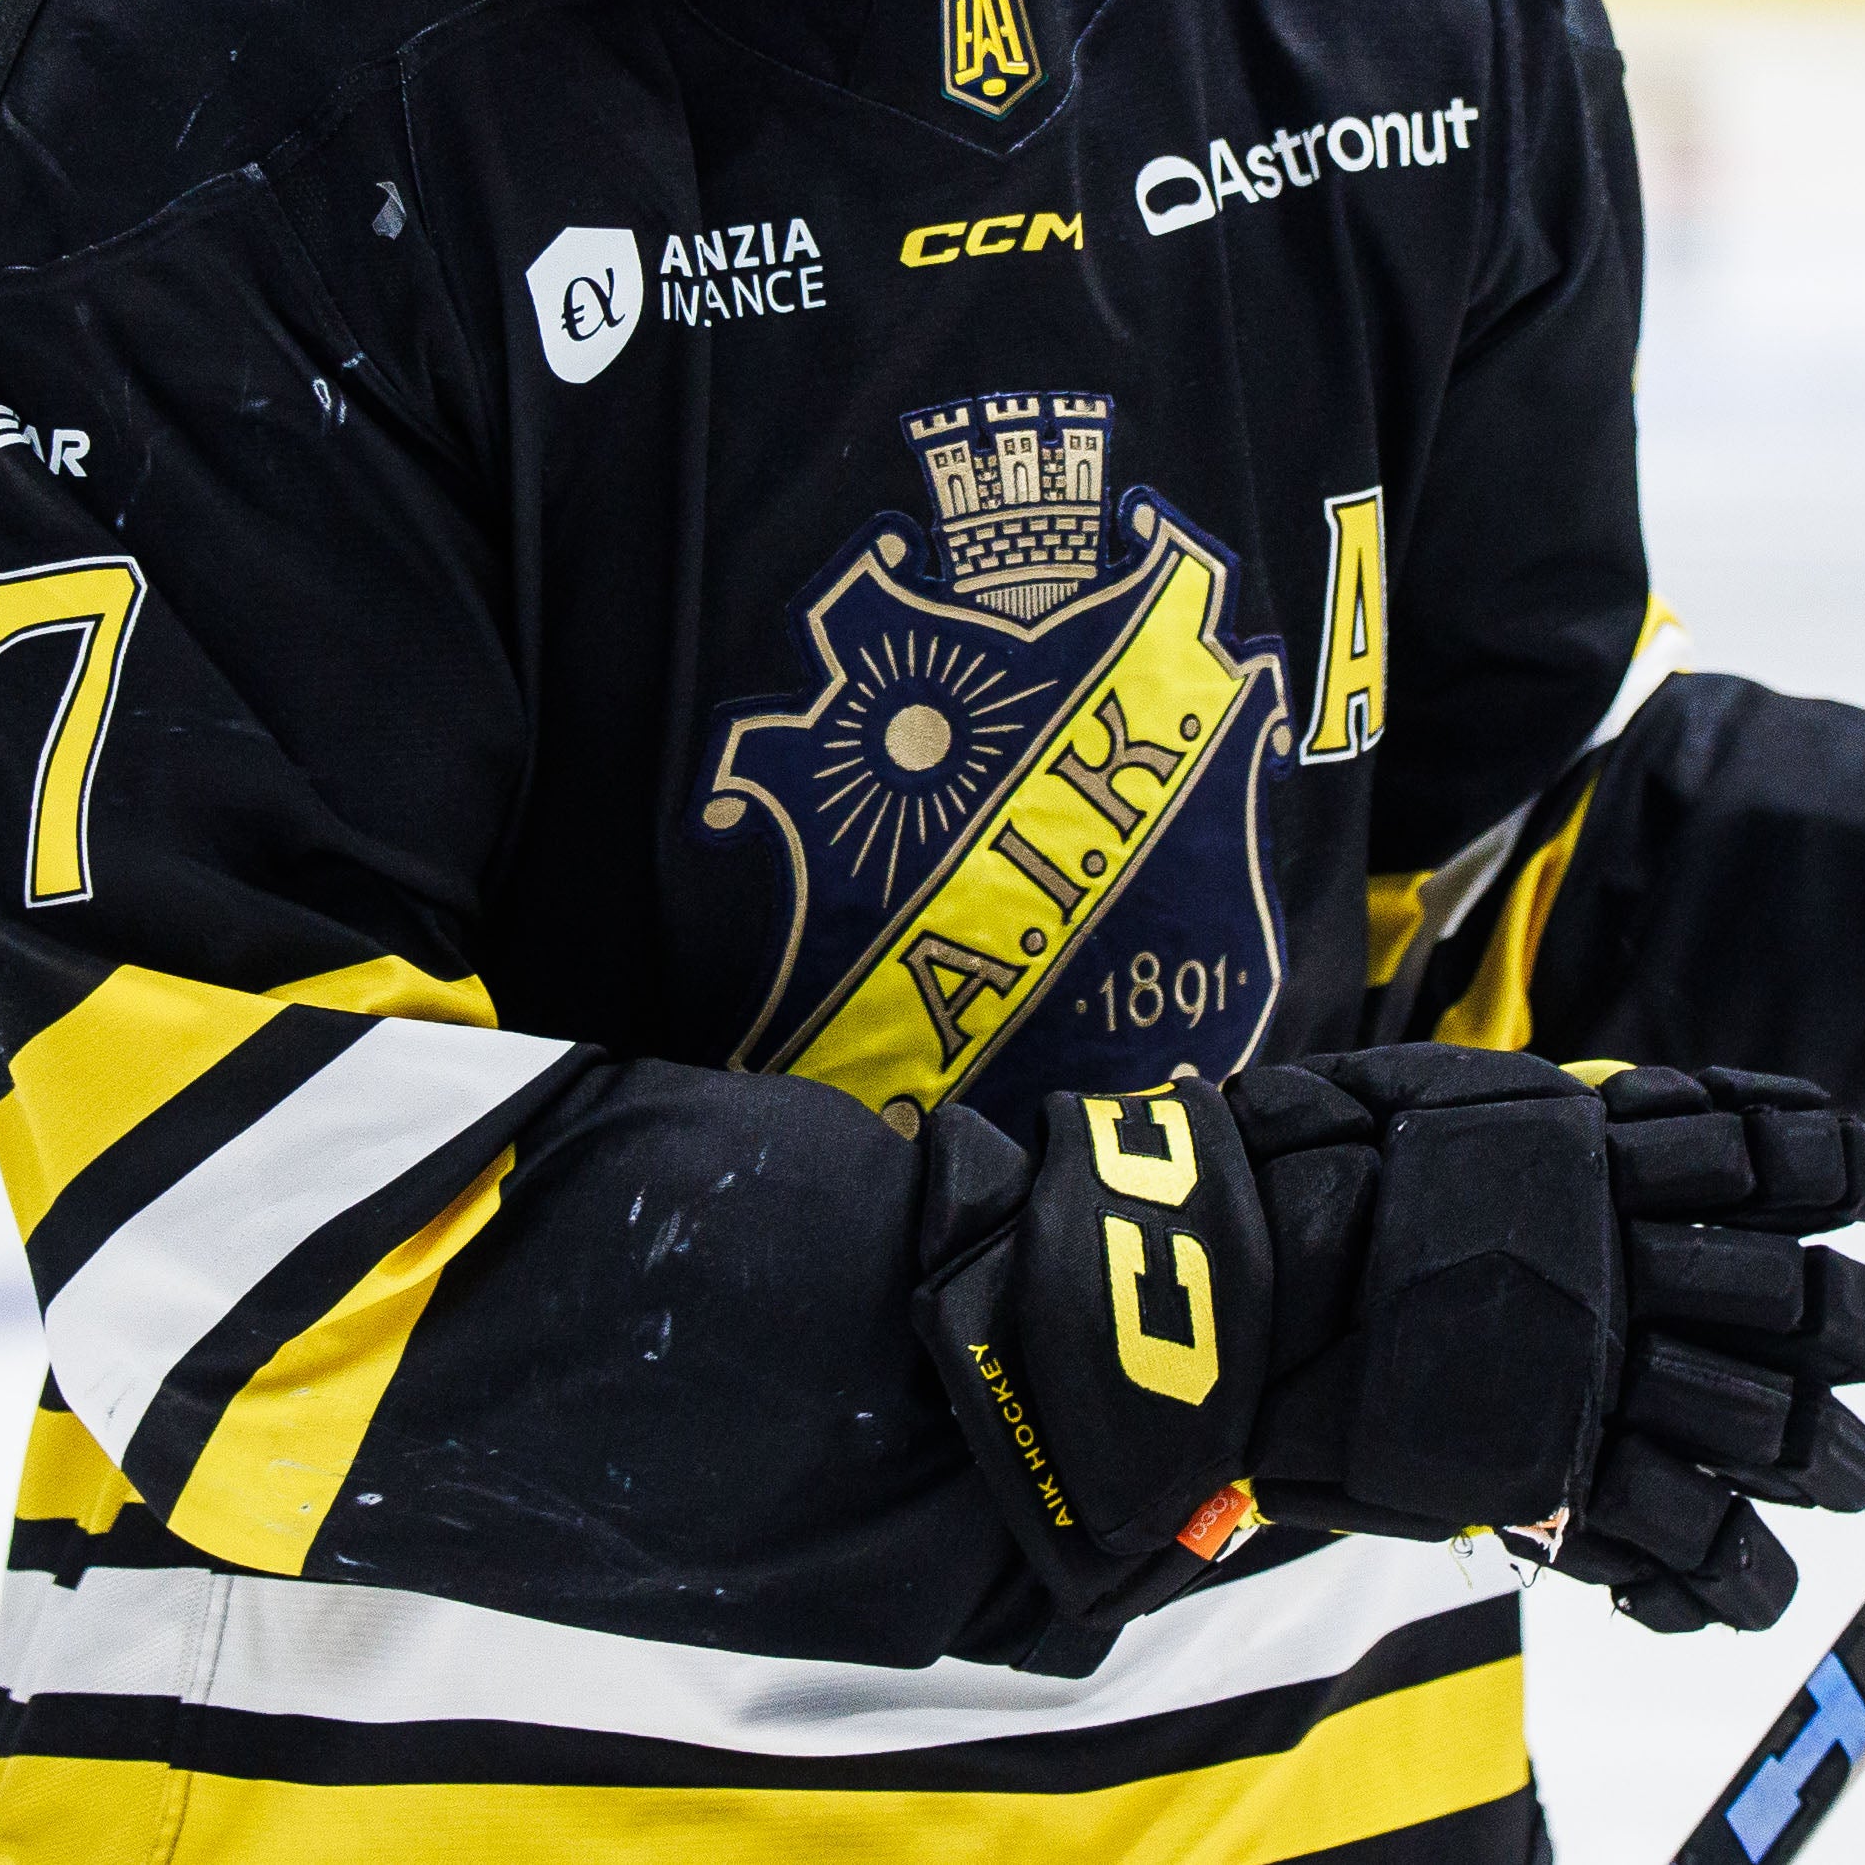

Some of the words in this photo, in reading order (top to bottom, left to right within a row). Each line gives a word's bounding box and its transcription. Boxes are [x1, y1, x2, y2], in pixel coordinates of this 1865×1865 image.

[1209, 97, 1479, 213] Astronut
[899, 211, 1084, 269] CCM
[1300, 486, 1390, 766] A
[1082, 1083, 1220, 1407] CC
[966, 1342, 1047, 1472] HOCKEY
[1037, 1472, 1075, 1528] AIK
